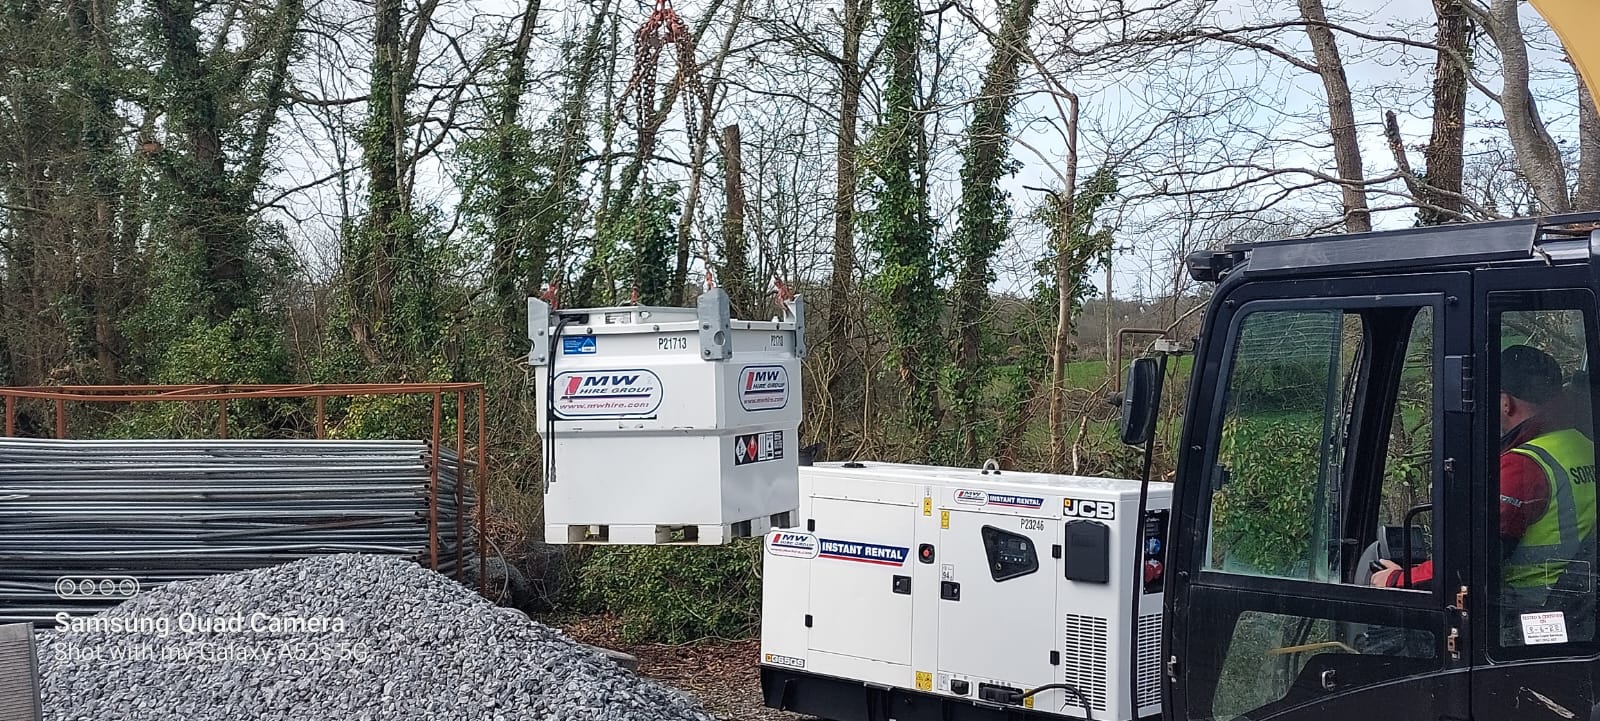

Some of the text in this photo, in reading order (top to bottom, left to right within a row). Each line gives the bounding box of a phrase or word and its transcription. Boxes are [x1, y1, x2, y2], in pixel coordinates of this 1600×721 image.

[658, 337, 687, 350] P21713
[584, 375, 640, 387] MW
[755, 371, 779, 381] MW
[560, 402, 649, 410] www.mwhire.com
[989, 495, 1015, 504] INSTANT
[1016, 498, 1041, 506] RENTAL
[1064, 500, 1114, 519] JCB
[1020, 518, 1044, 531] P23246
[782, 534, 808, 542] MW
[822, 541, 861, 555] INSTANT
[867, 547, 903, 560] RENTAL
